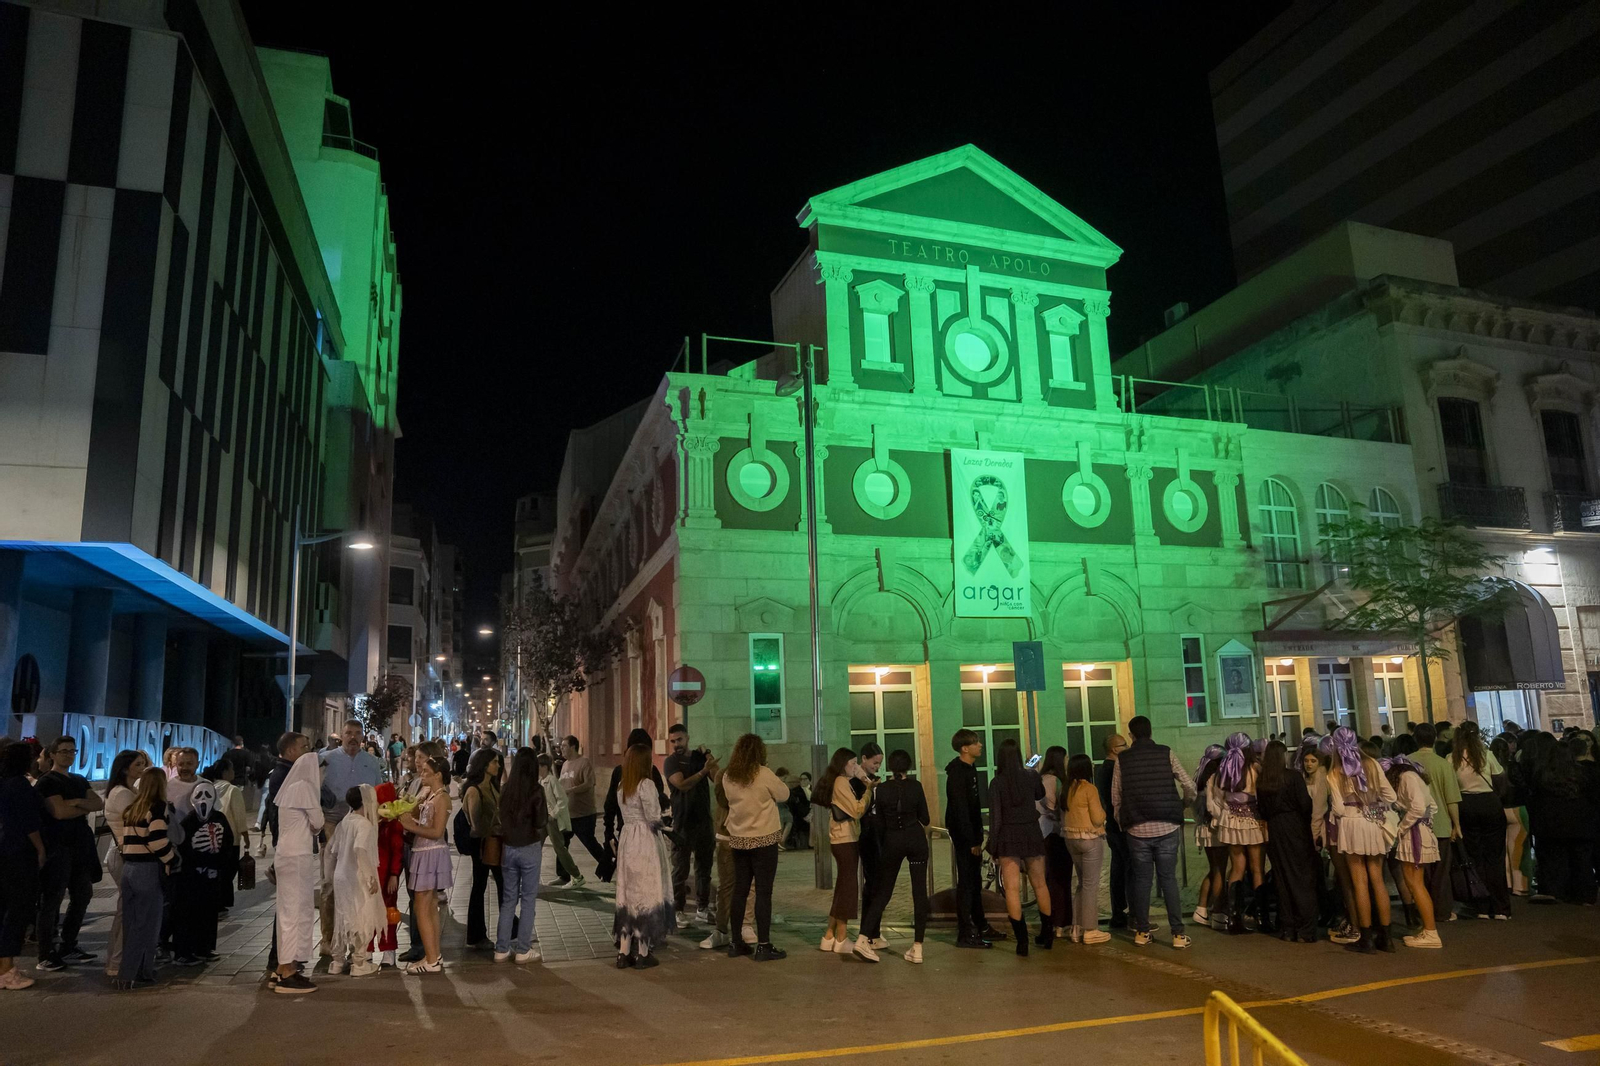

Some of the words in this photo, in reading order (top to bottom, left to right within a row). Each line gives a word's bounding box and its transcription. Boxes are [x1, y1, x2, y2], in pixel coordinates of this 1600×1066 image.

[888, 239, 969, 264] TEATRO
[989, 254, 1050, 276] APOLO
[963, 584, 1024, 611] argar
[1516, 682, 1554, 690] ROBERTO
